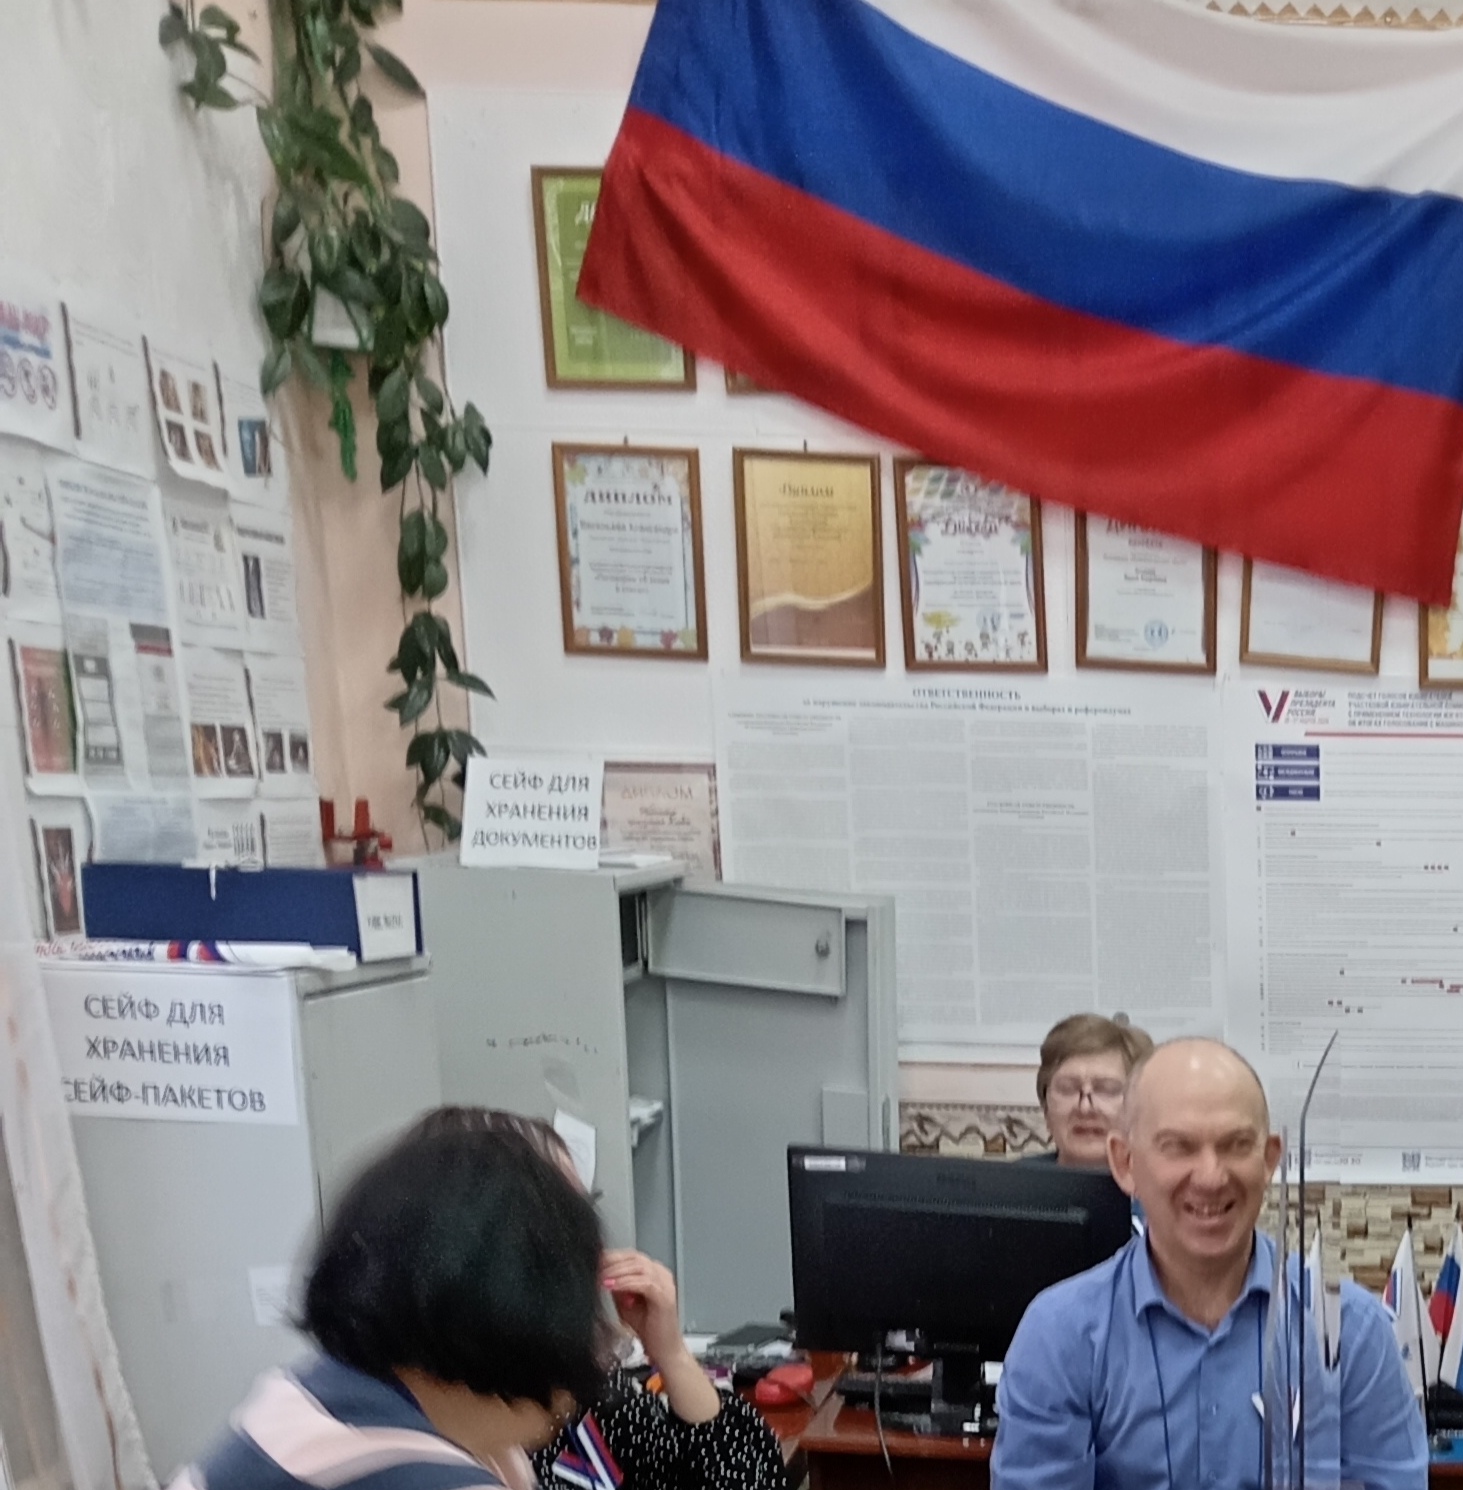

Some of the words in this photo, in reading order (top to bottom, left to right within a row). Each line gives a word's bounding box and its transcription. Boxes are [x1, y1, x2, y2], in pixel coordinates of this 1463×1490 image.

[912, 687, 1021, 701] ОТВЕТСТВЕННОСТЬ
[489, 772, 543, 791] СЕЙФ
[548, 773, 590, 794] ДЛЯ
[486, 801, 589, 822] ХРАНЕНИЯ
[472, 829, 597, 850] ДОКУМЕНТОВ
[84, 992, 160, 1020] СЕЙФ
[167, 998, 225, 1028] ДЛЯ
[86, 1036, 231, 1067] ХРАНЕНИЯ
